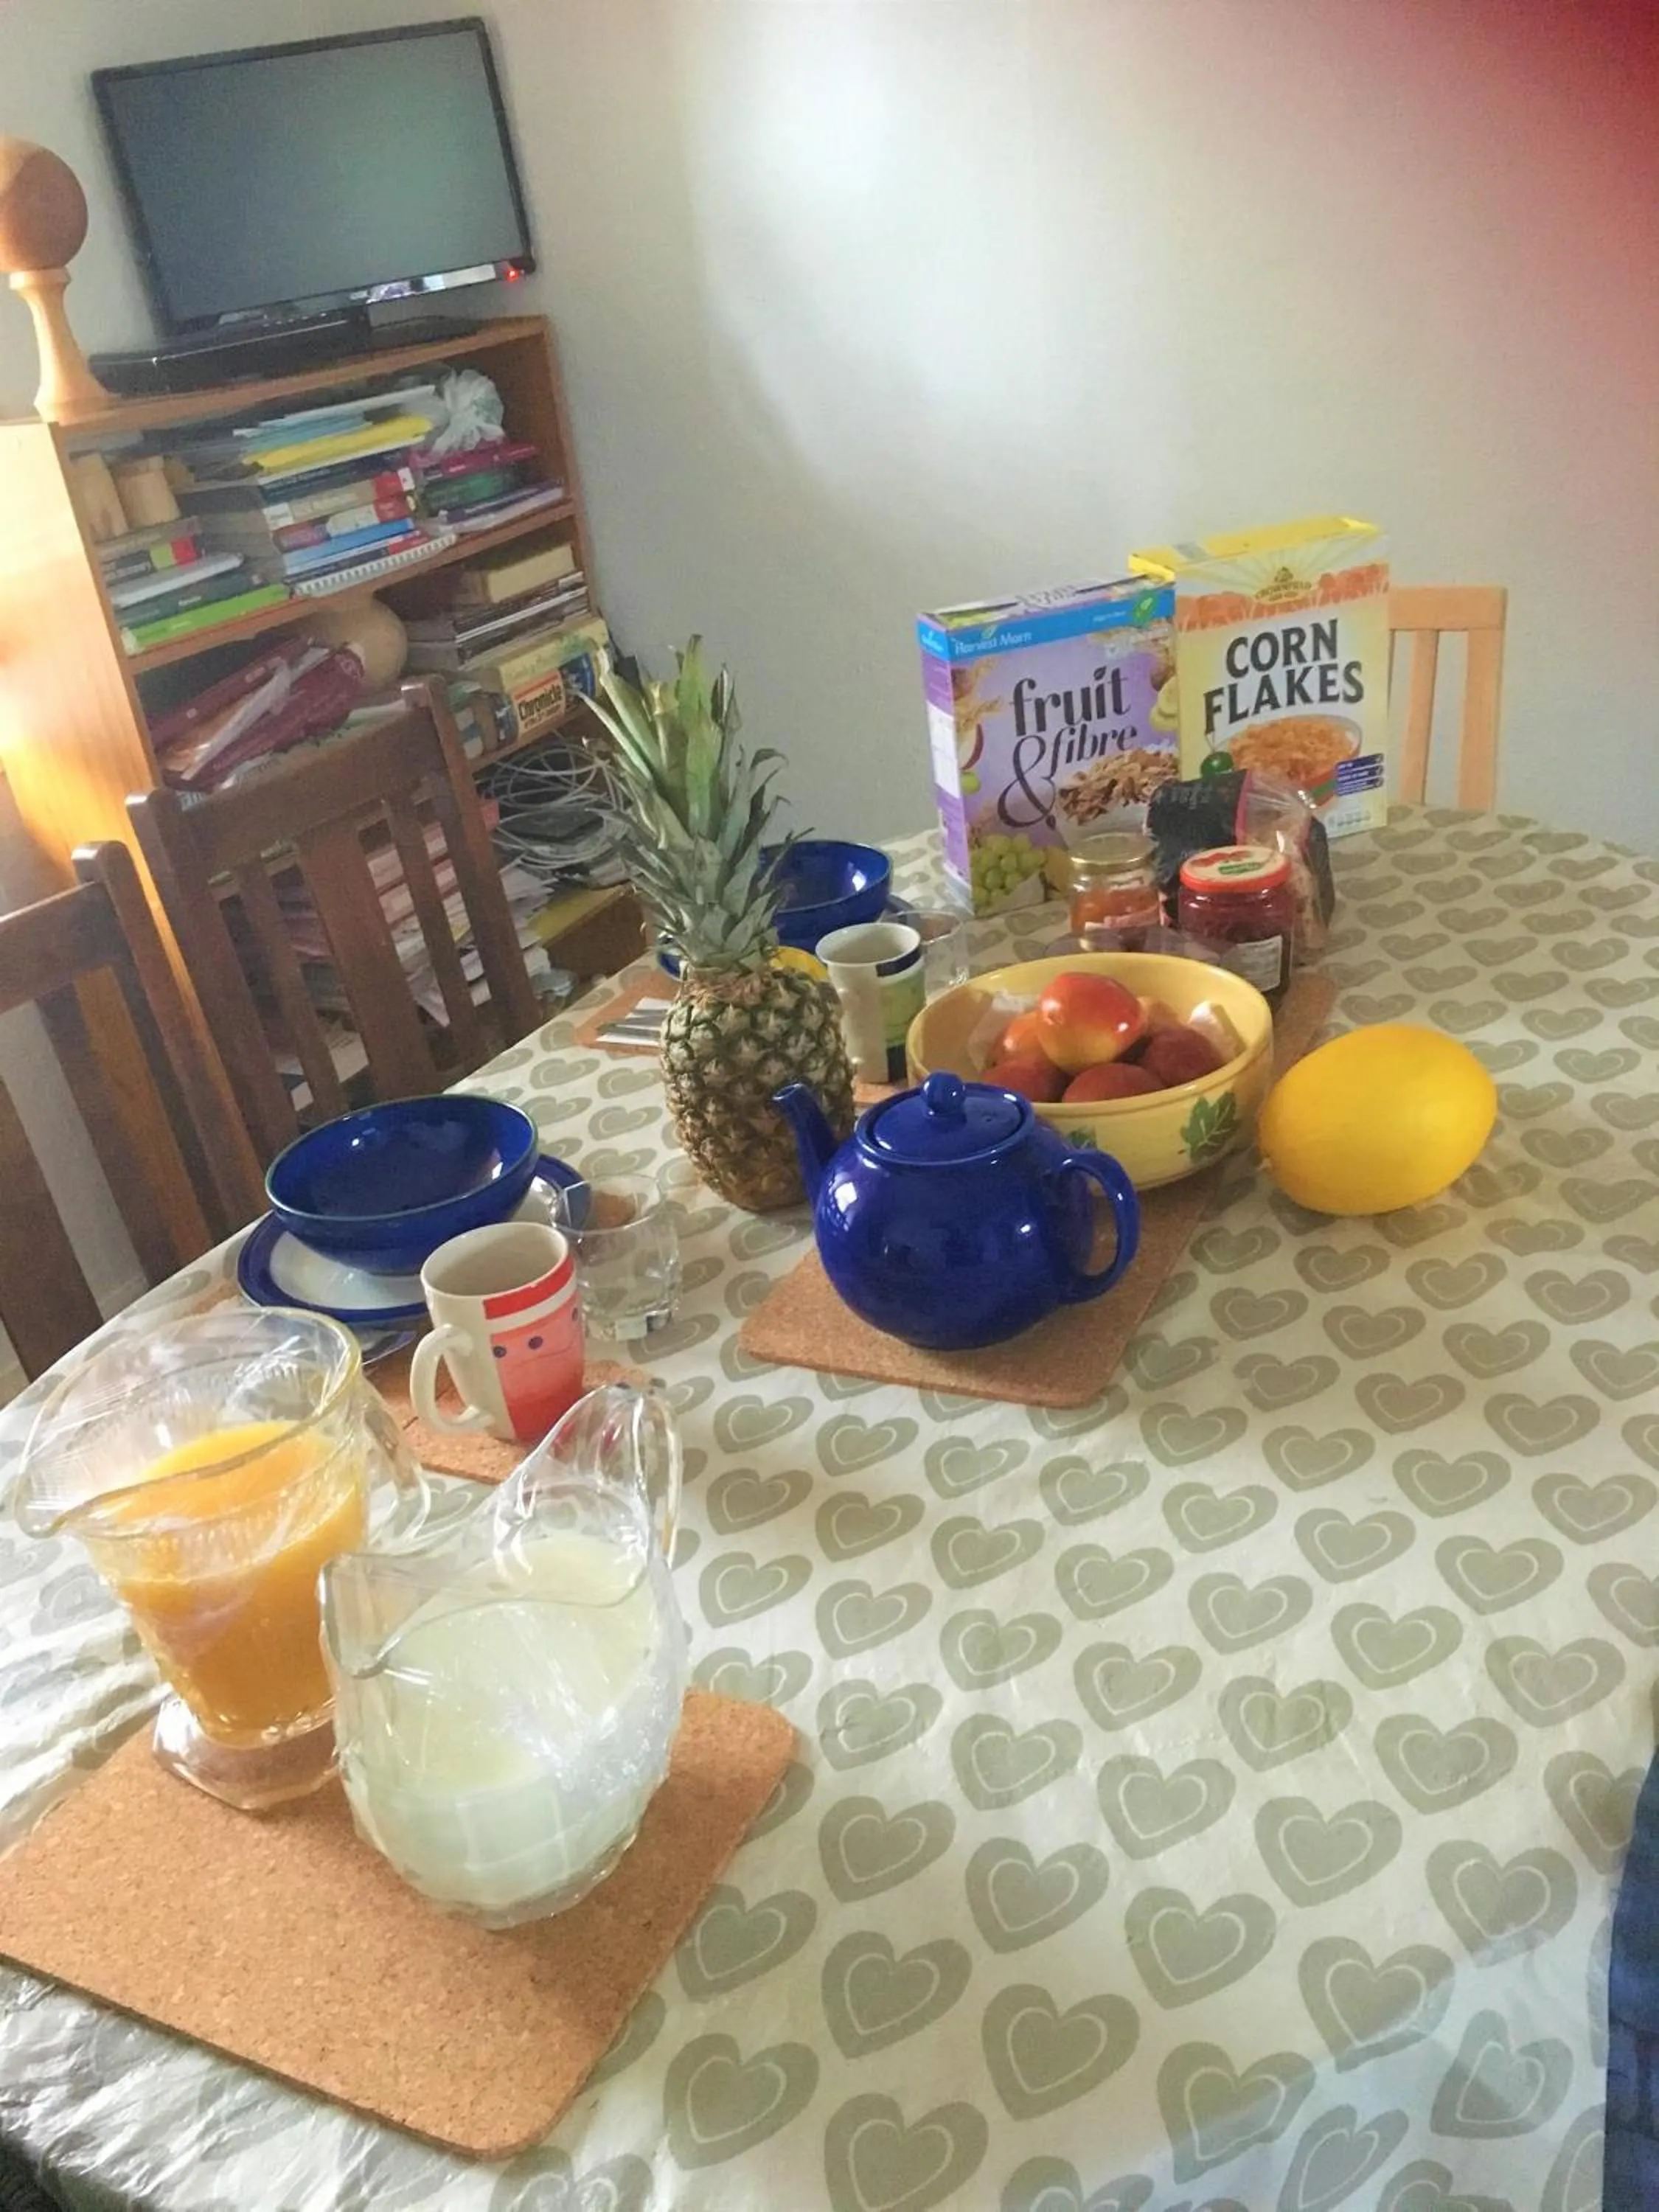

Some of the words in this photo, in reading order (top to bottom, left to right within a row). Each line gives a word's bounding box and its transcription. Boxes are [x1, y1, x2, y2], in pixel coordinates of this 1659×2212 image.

[1226, 618, 1338, 679] CORN
[1009, 666, 1131, 736] fruit
[1203, 661, 1364, 735] FLAKES
[997, 735, 1056, 830] &
[1041, 723, 1138, 779] fibre
